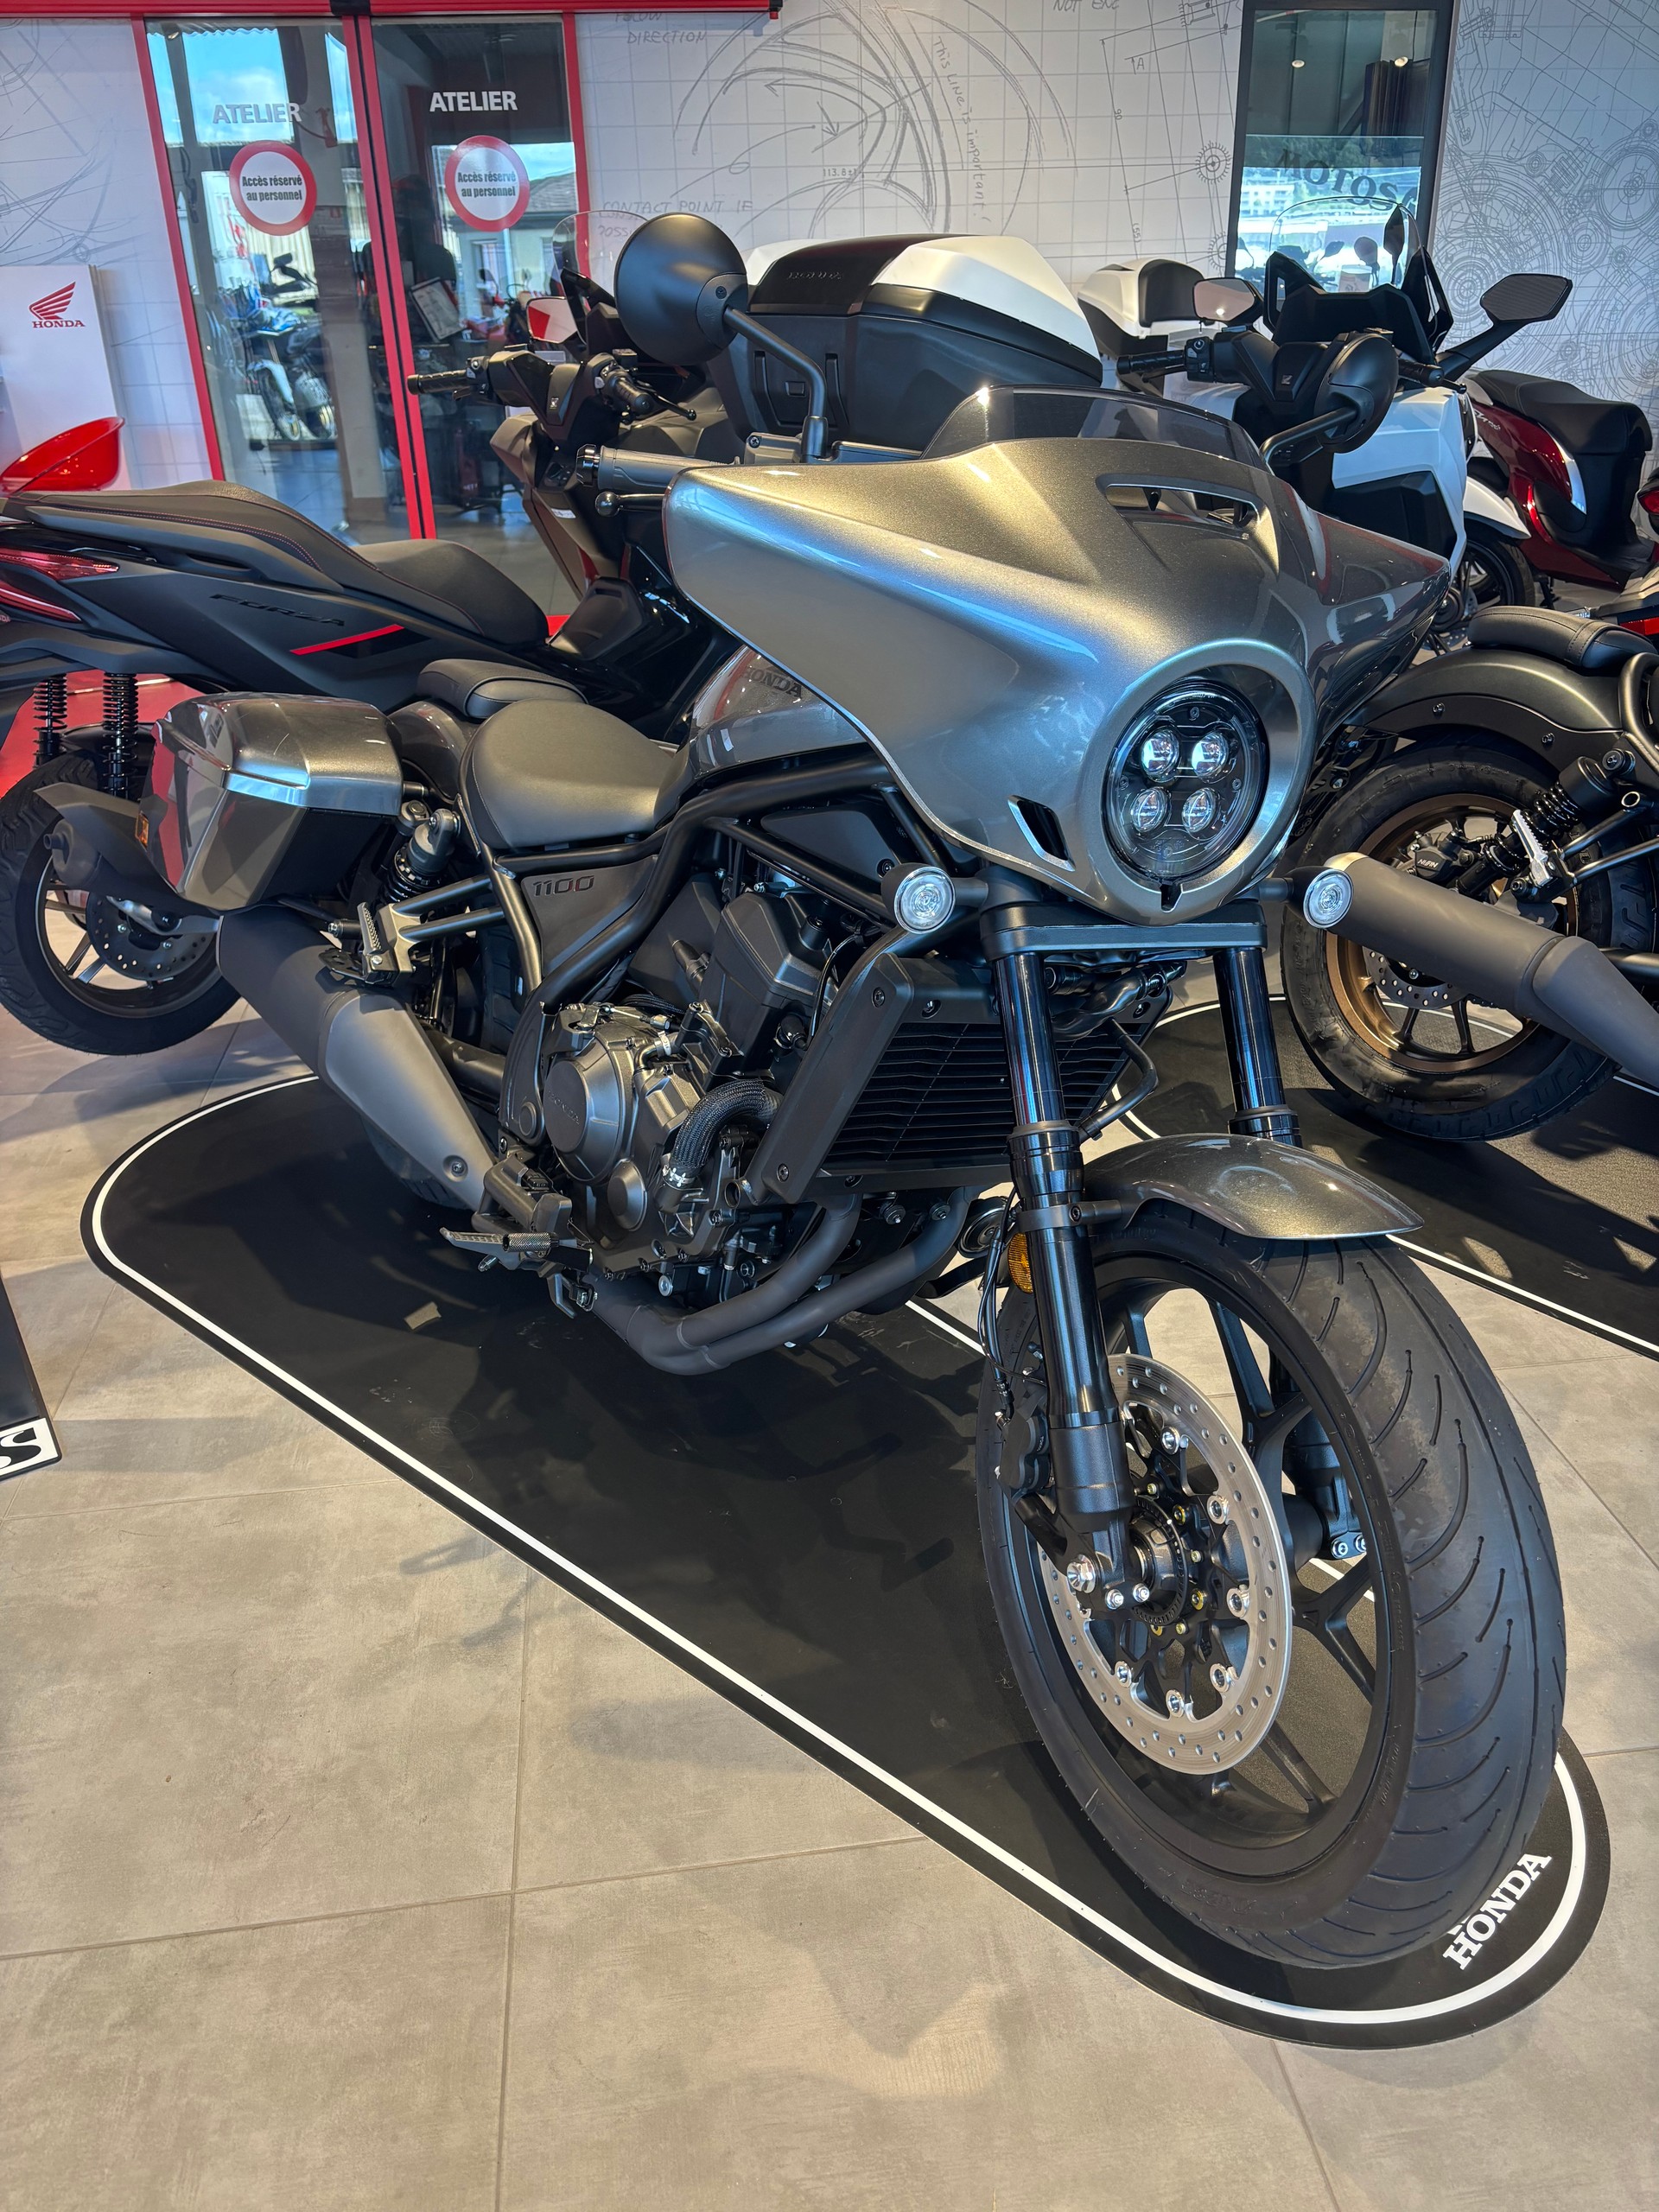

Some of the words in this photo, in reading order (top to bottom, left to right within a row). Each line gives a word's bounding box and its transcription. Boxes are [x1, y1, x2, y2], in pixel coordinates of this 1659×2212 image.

[627, 31, 707, 44] DIRECTION
[1136, 58, 1145, 70] A
[429, 91, 518, 112] ATELIER
[213, 102, 302, 124] ATELIER
[242, 175, 268, 187] Accès
[269, 175, 302, 187] réservé
[457, 172, 483, 183] Accès
[484, 172, 517, 182] réservé
[246, 190, 257, 201] au
[259, 189, 302, 202] personnel
[461, 188, 472, 198] au
[474, 186, 516, 198] personnel
[603, 200, 673, 214] CONTACT
[678, 200, 725, 214] POINT
[32, 320, 86, 328] HONDA
[741, 665, 802, 699] HONDA
[532, 875, 594, 896] 1100
[1442, 1853, 1553, 1971] HONDA
